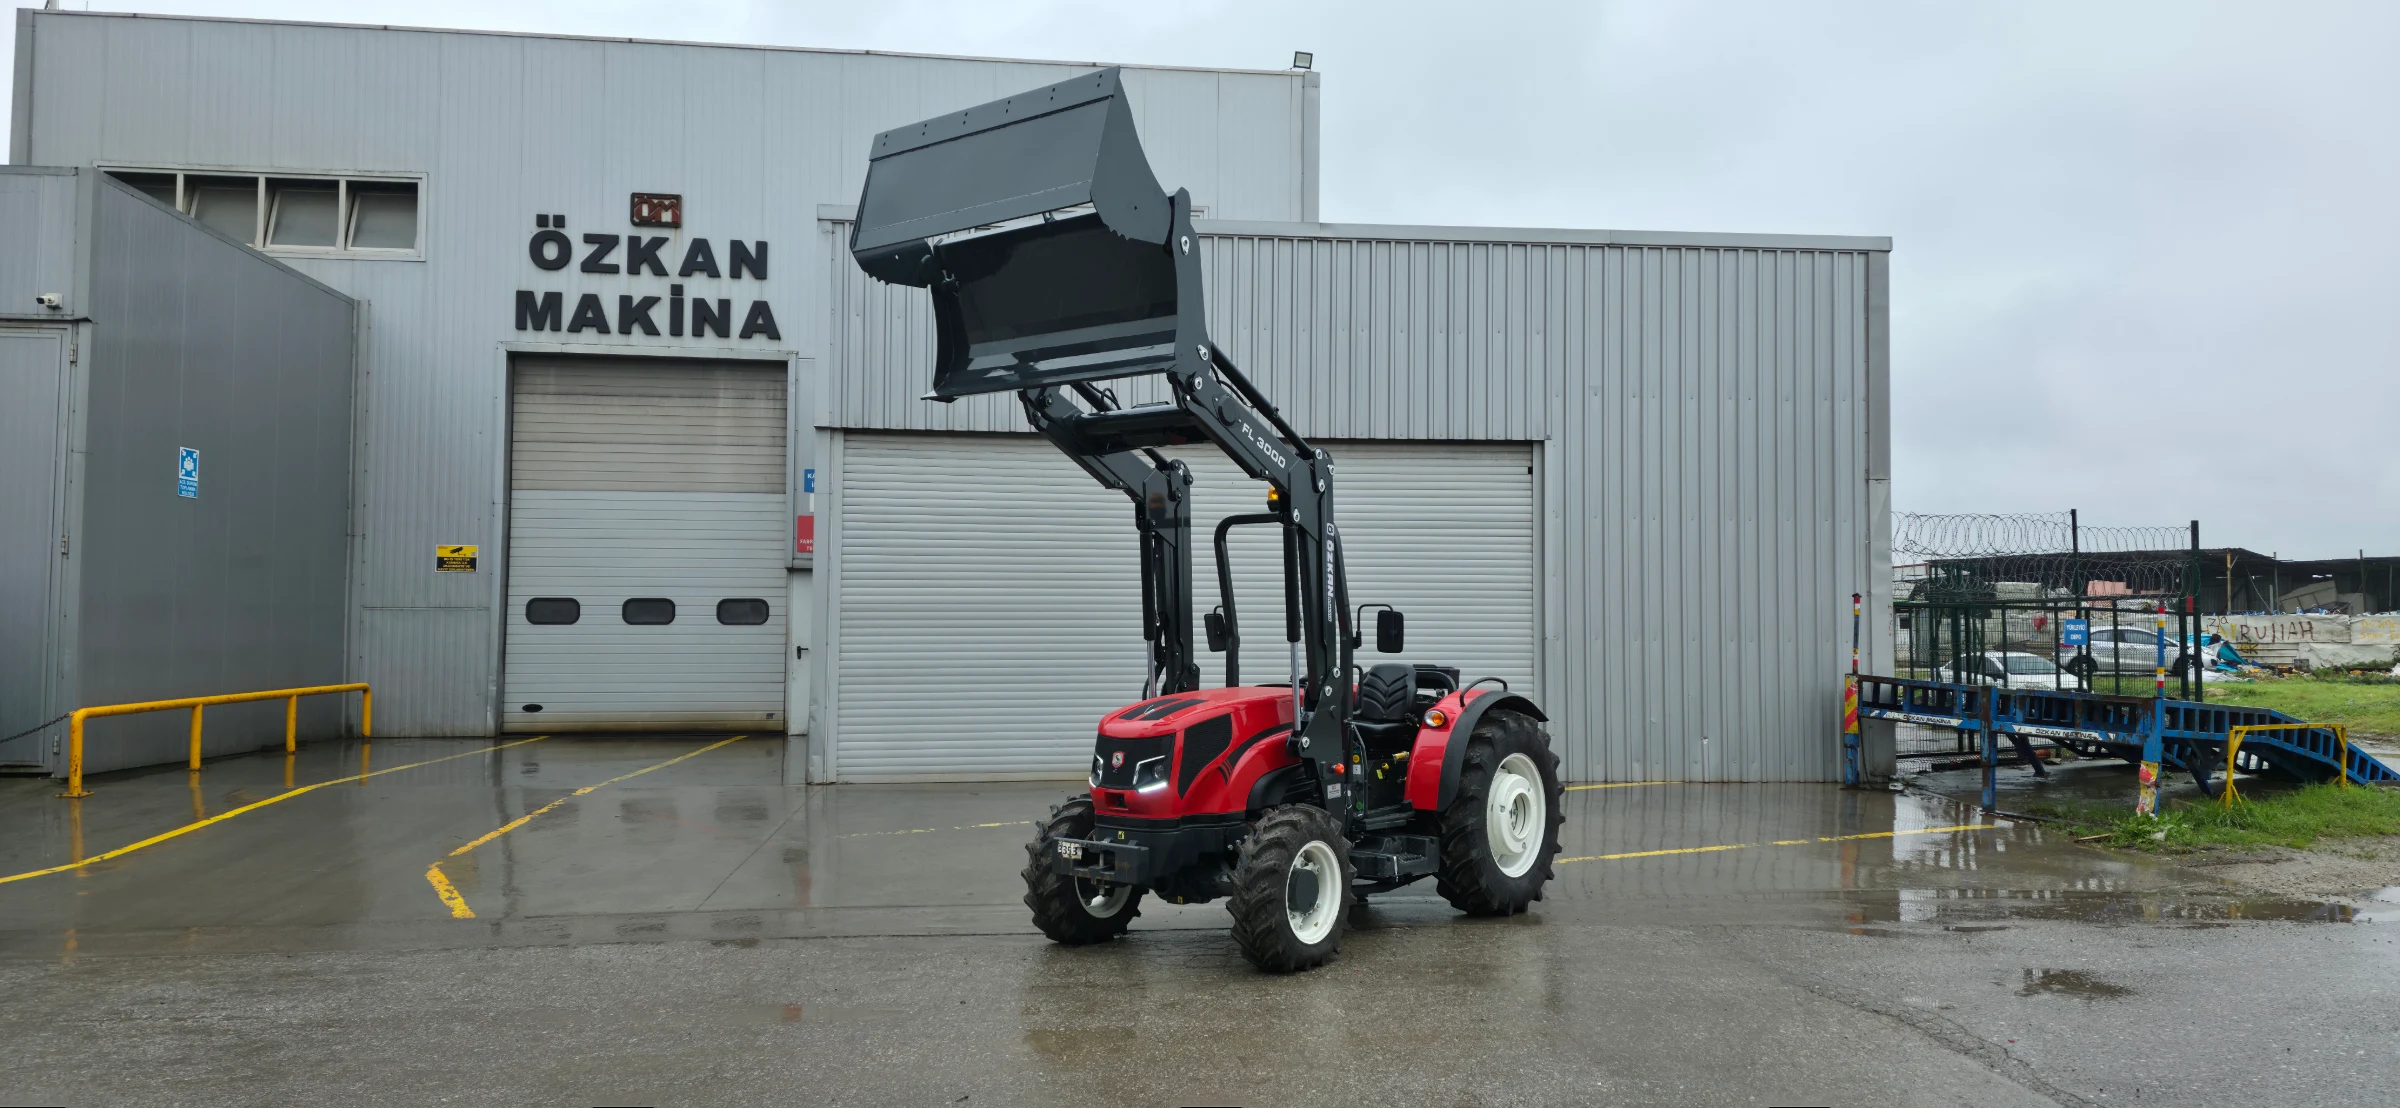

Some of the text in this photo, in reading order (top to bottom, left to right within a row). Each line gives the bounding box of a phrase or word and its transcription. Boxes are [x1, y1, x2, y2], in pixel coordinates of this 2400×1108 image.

[529, 213, 768, 280] ÖZKAN
[515, 283, 782, 341] MAKİNA
[1241, 422, 1286, 469] FL 3000
